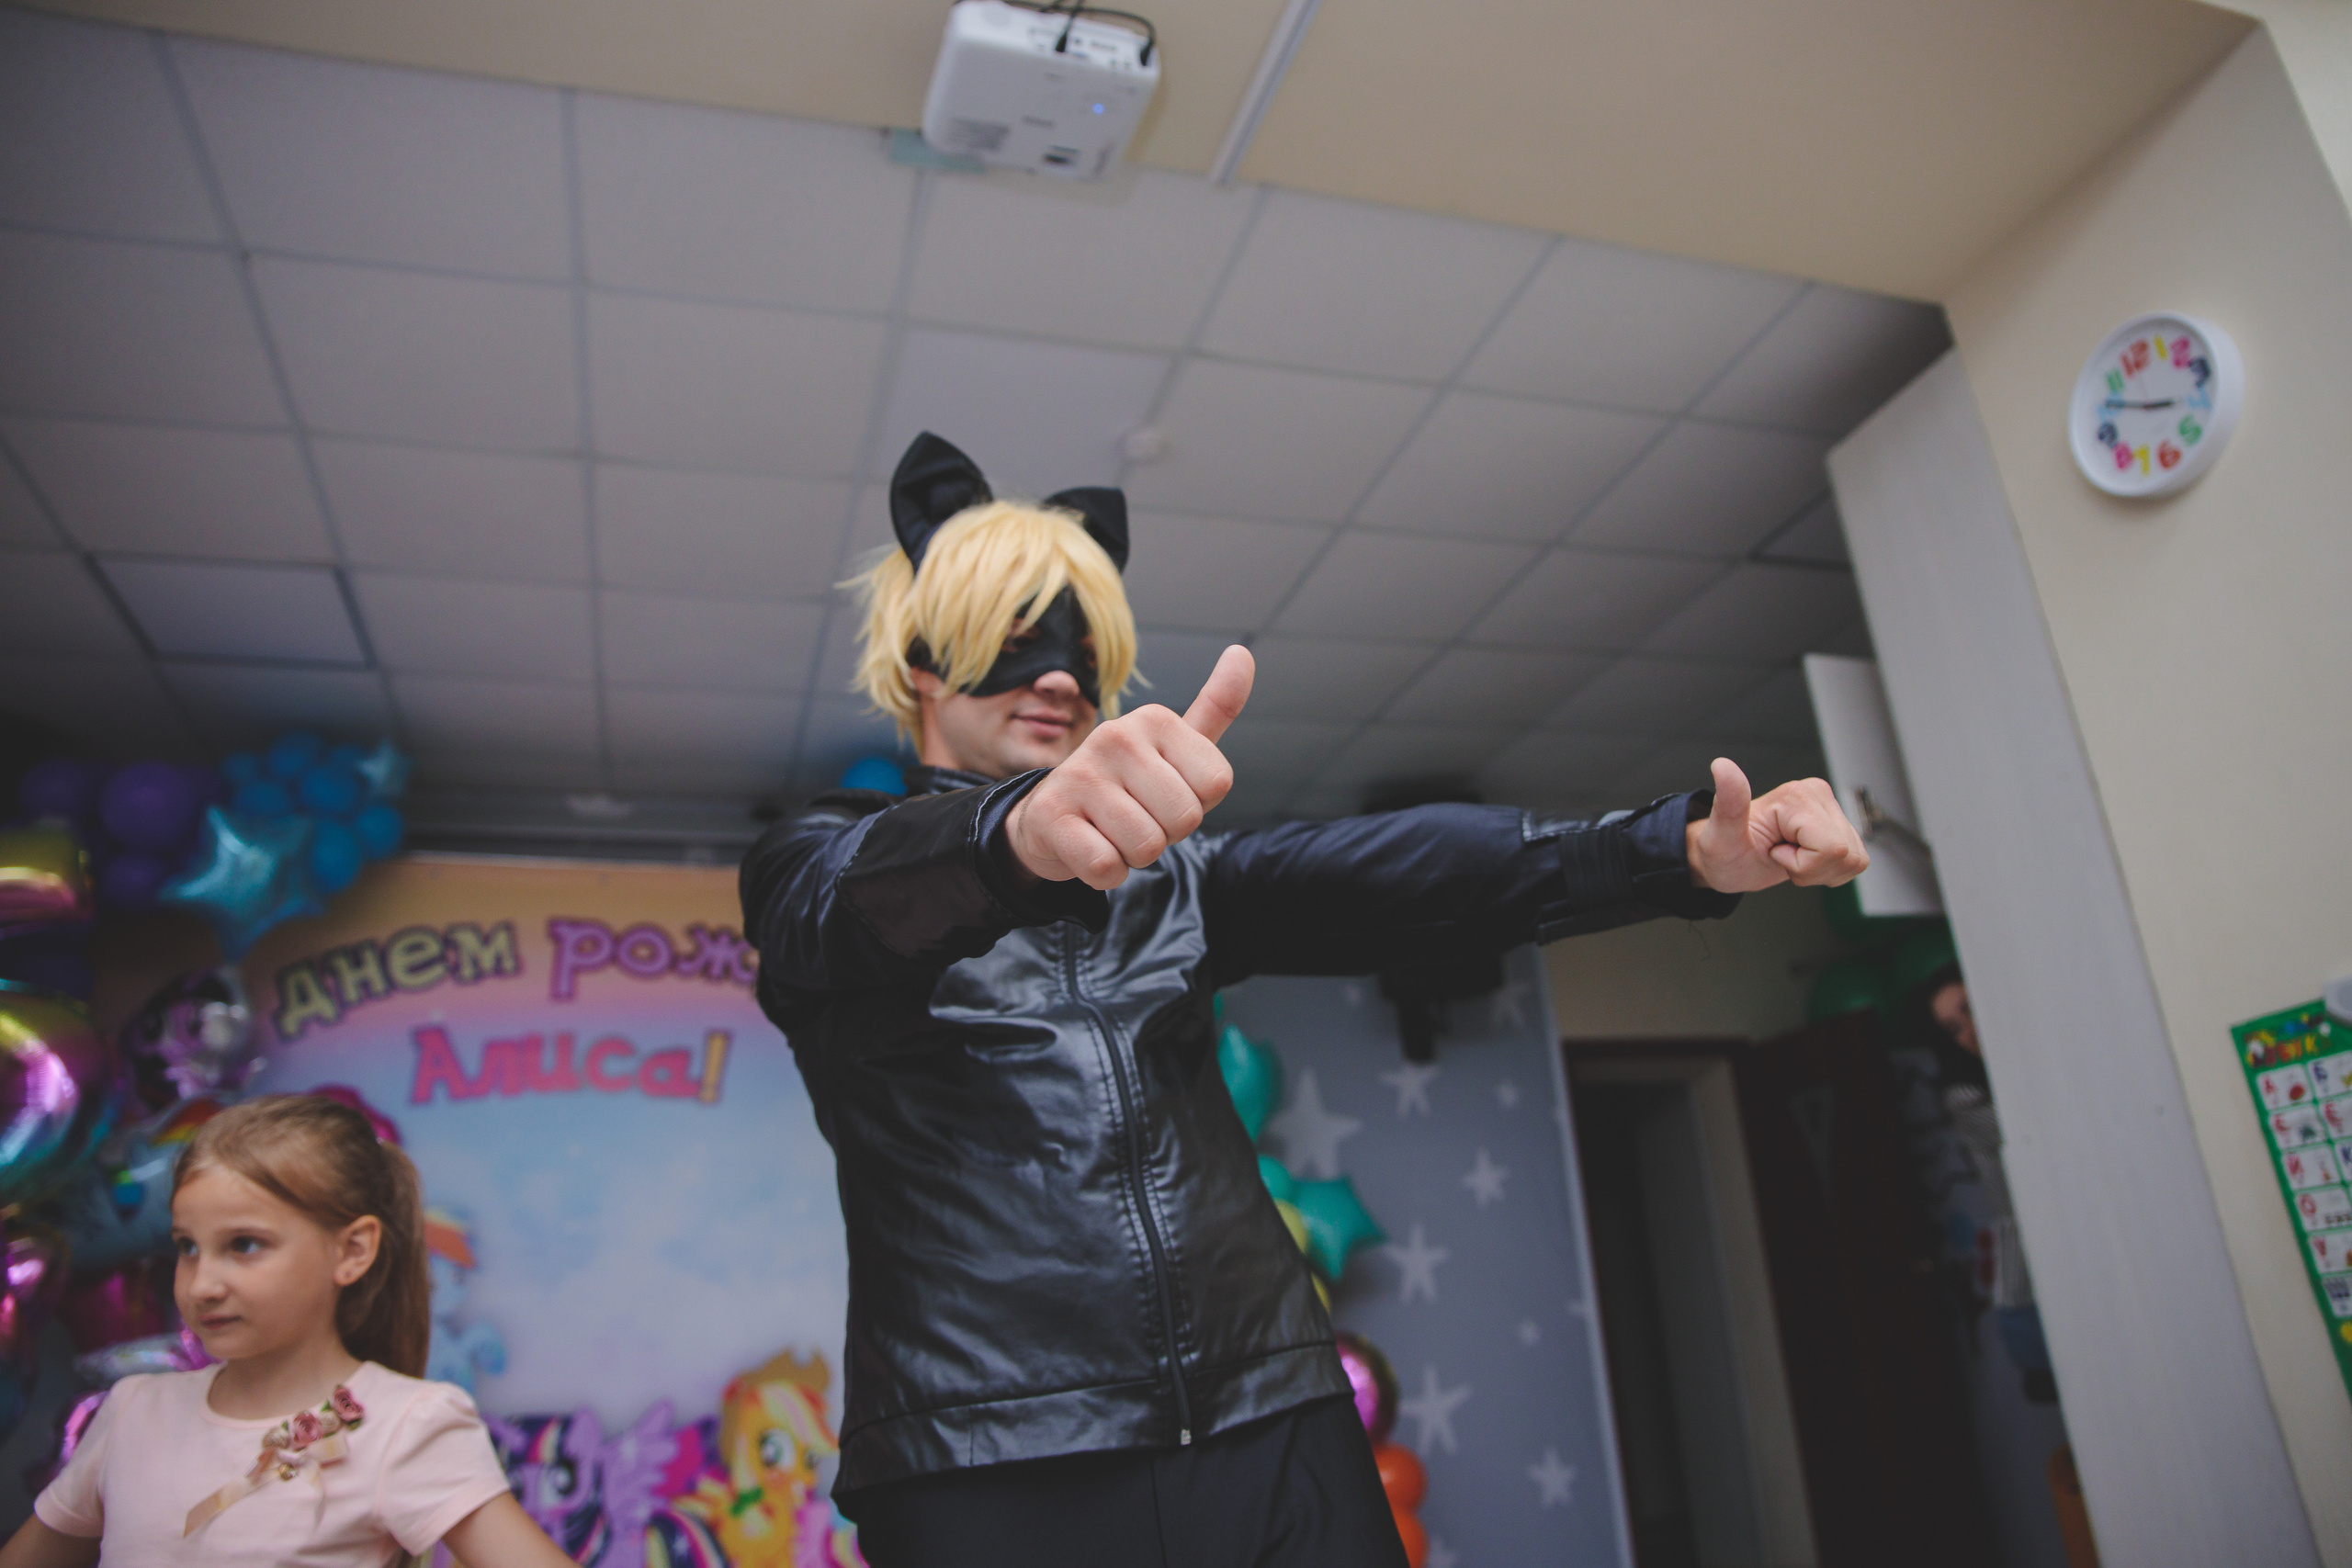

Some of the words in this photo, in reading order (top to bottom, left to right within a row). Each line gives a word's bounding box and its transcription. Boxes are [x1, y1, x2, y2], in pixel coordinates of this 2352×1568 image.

[2120, 338, 2150, 378] 12
[2169, 336, 2190, 369] 2
[2178, 413, 2202, 446] 5
[2158, 439, 2181, 471] 6
